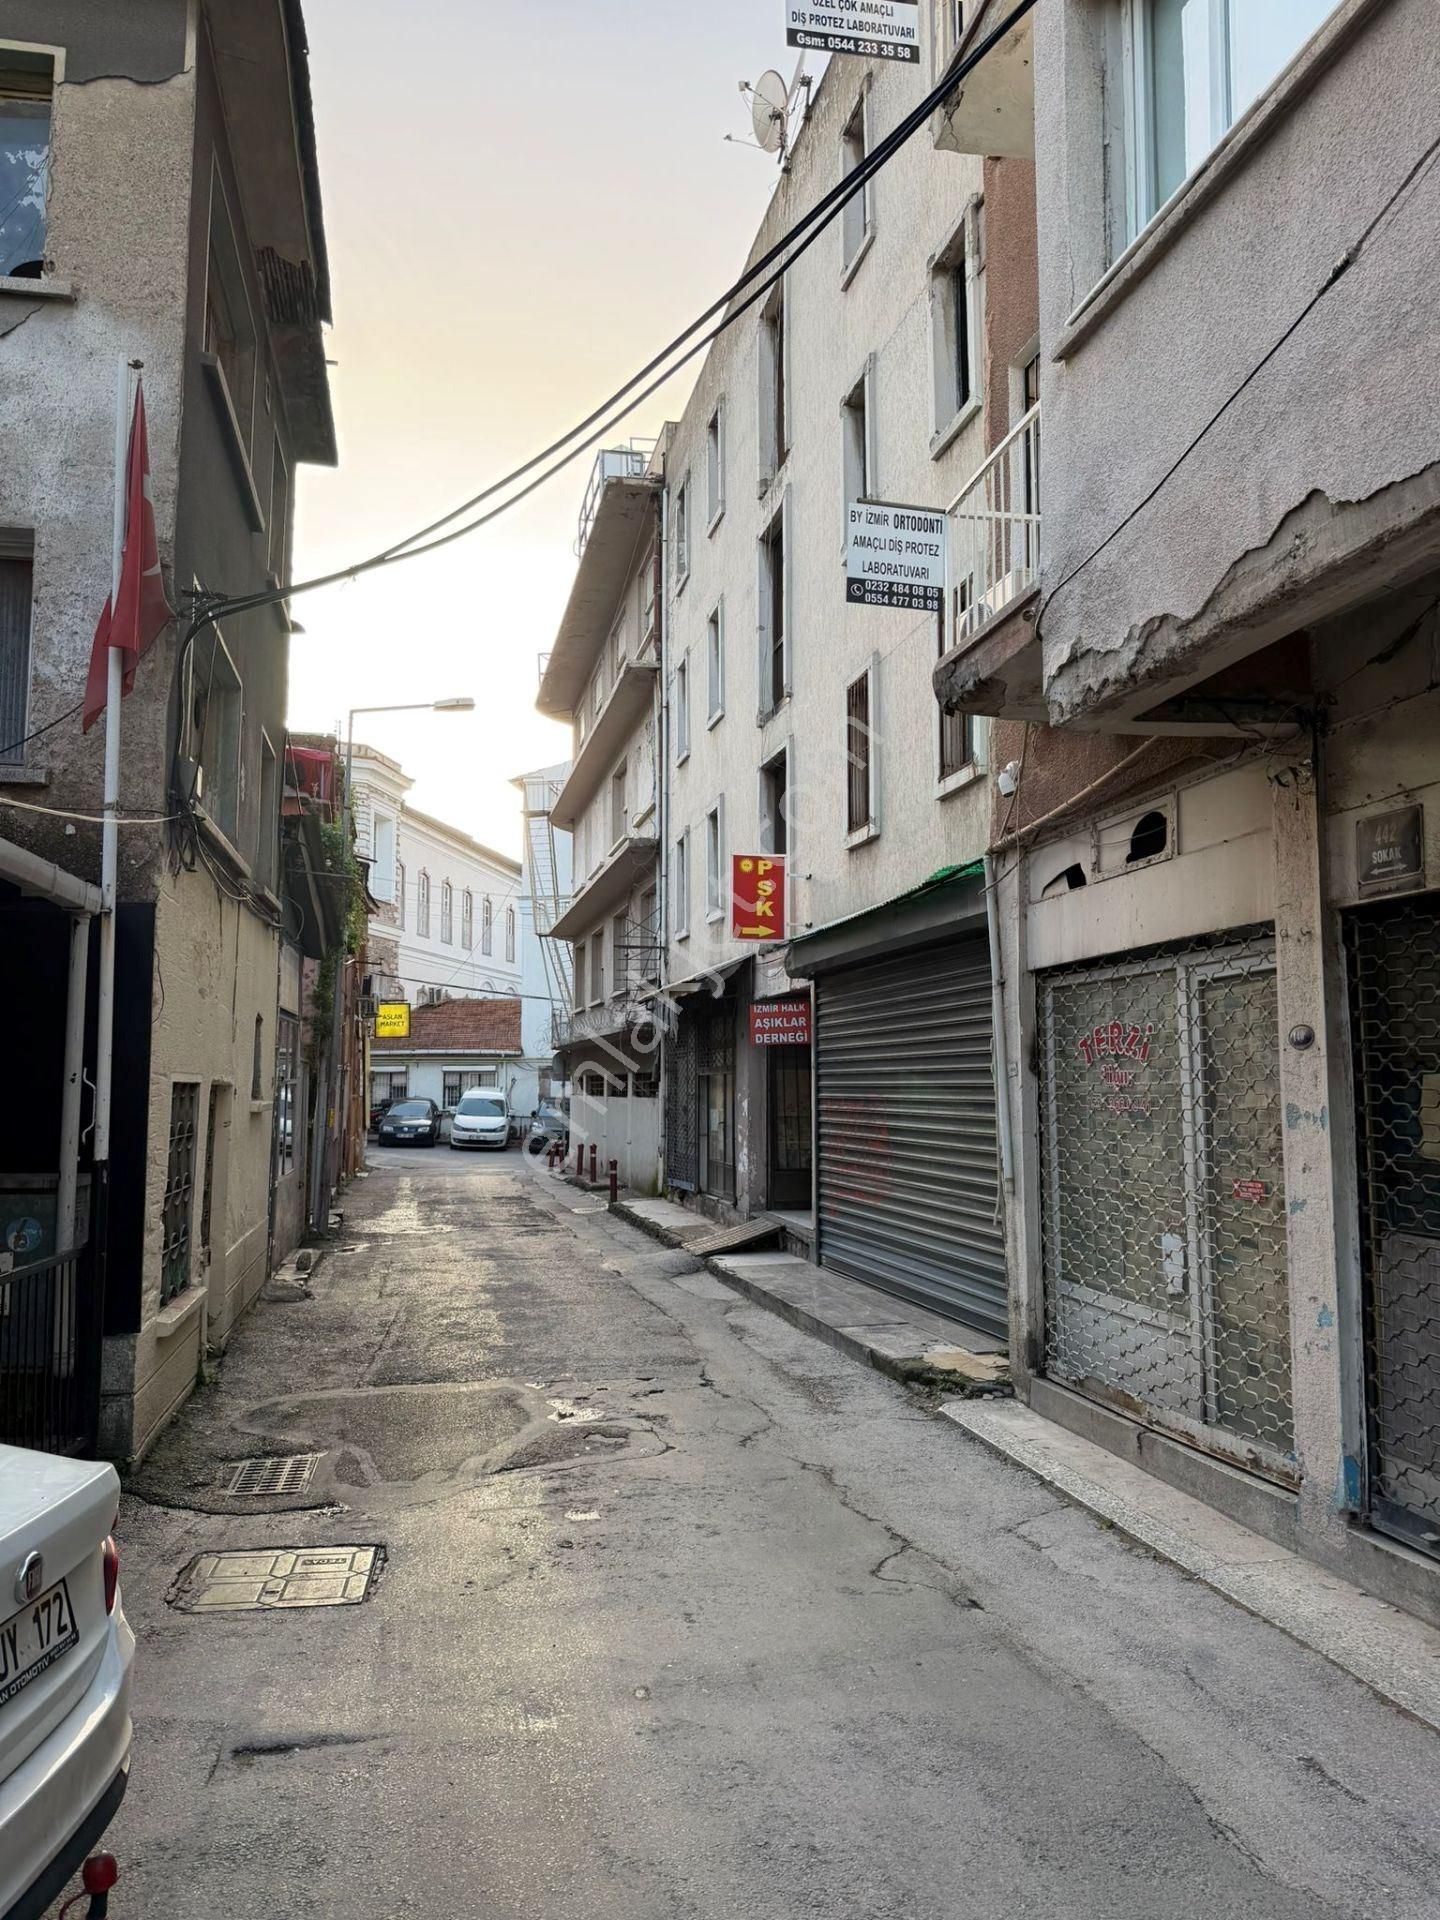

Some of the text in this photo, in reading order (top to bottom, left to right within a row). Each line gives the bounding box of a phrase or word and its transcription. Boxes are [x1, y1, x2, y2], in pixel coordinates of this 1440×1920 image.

[859, 2, 894, 19] AMAÇLI
[791, 9, 915, 39] DİŞ PROTEZ LABORATUVARI
[796, 33, 911, 59] Gsm: 0544 233 35 58
[850, 508, 943, 534] BY İZMİR ORTODONTİ
[852, 535, 940, 557] AMAÇLI DİŞ PROTEZ
[861, 560, 930, 580] LABORATUVARI
[865, 580, 939, 597] 0232 484 08 05
[864, 593, 939, 610] 0554 477 03 98
[1371, 846, 1402, 865] SOKAK
[781, 1003, 806, 1012] HALK
[754, 1016, 807, 1030] AŞIKLAR
[755, 1030, 808, 1044] DERNEĞİ
[32, 1591, 68, 1650] 172
